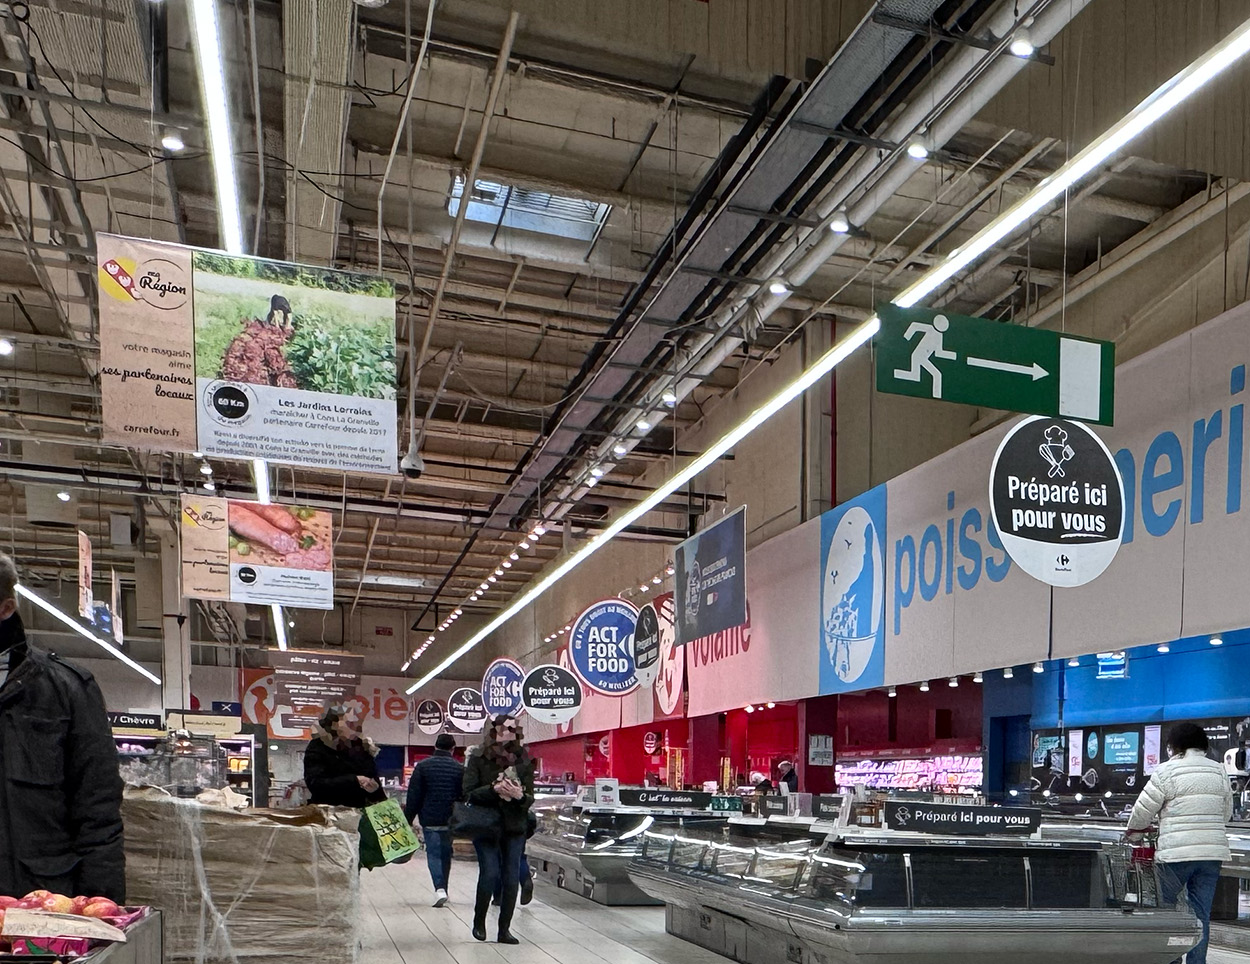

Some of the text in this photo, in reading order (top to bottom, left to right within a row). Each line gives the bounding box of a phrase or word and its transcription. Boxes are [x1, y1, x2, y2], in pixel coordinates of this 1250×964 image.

[139, 276, 187, 298] Région
[122, 342, 149, 355] votre
[155, 384, 194, 401] locaux
[279, 398, 373, 417] Les Jardins Lorrains
[123, 422, 181, 438] carrefour.fr
[1007, 475, 1107, 506] Préparé ici
[1011, 508, 1106, 532] pour vous
[588, 626, 619, 643] ACT
[588, 643, 617, 658] FOR
[588, 658, 629, 673] FOOD
[491, 676, 506, 687] ACT
[490, 687, 506, 698] FOR
[529, 686, 575, 698] Préparé ici
[490, 697, 513, 708] FOOD
[530, 697, 551, 707] pour
[120, 715, 155, 726] Chèvre
[915, 810, 1031, 825] Préparé ici pour vous
